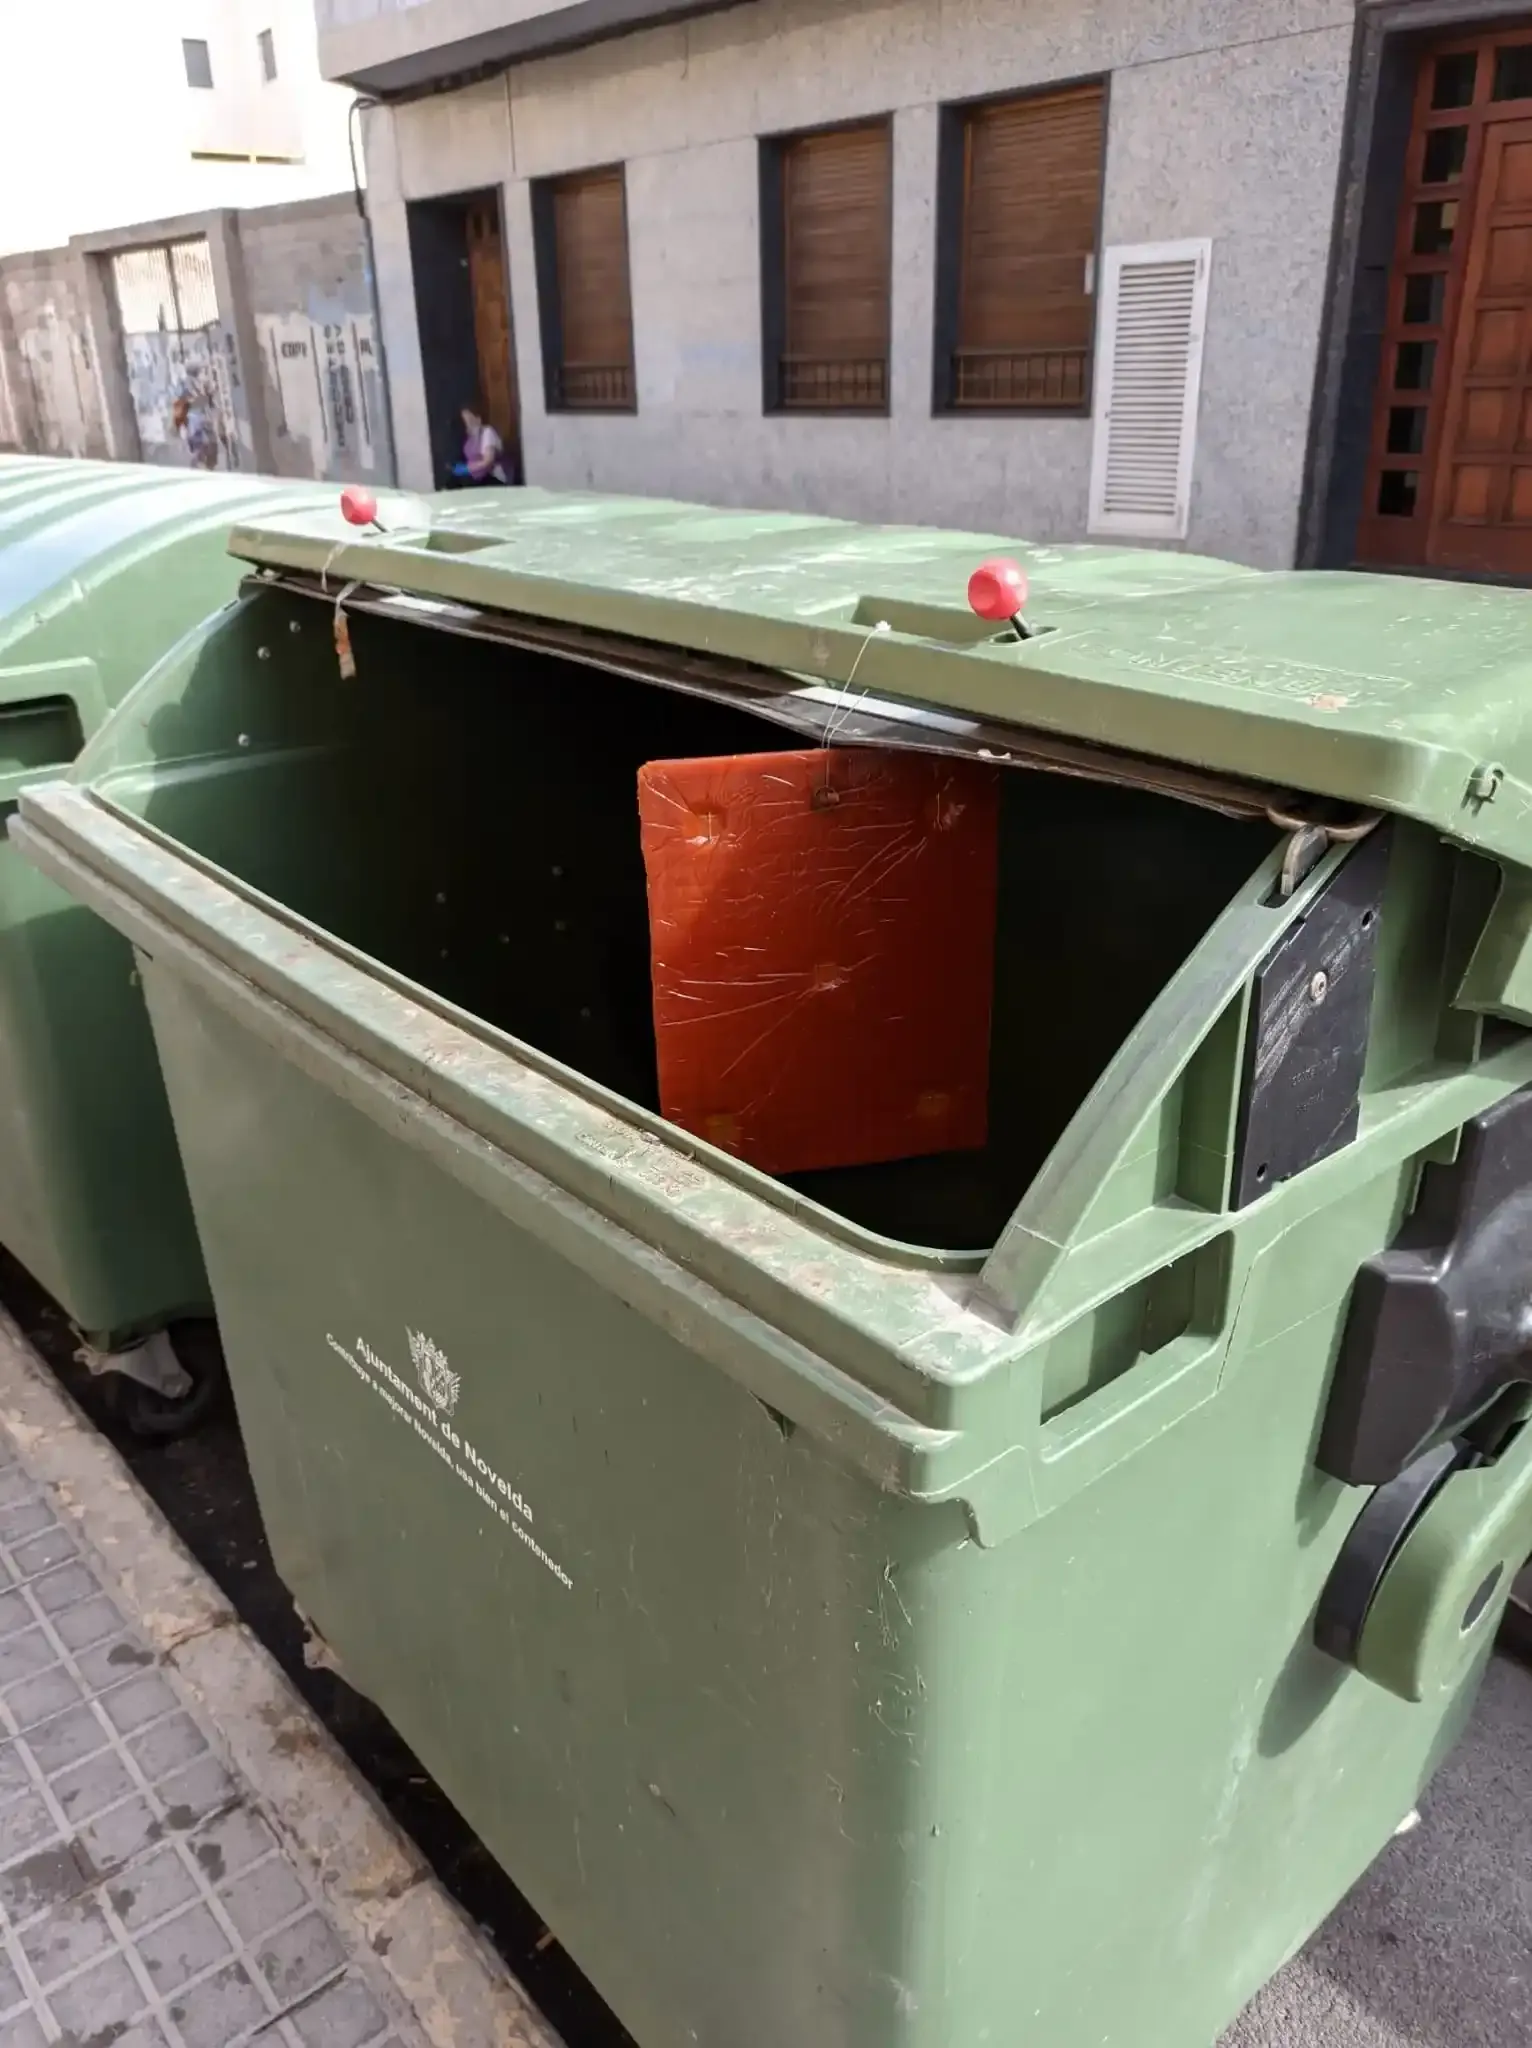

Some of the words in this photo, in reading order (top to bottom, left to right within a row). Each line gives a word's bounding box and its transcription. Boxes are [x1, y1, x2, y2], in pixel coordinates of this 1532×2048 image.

[356, 1336, 438, 1428] Ajuntament
[441, 1421, 460, 1449] de
[464, 1439, 534, 1523] Novelda
[413, 1418, 455, 1469] Novelda,
[456, 1464, 474, 1488] usa
[476, 1481, 498, 1512] bien
[499, 1507, 510, 1524] el
[511, 1521, 574, 1590] contenedor
